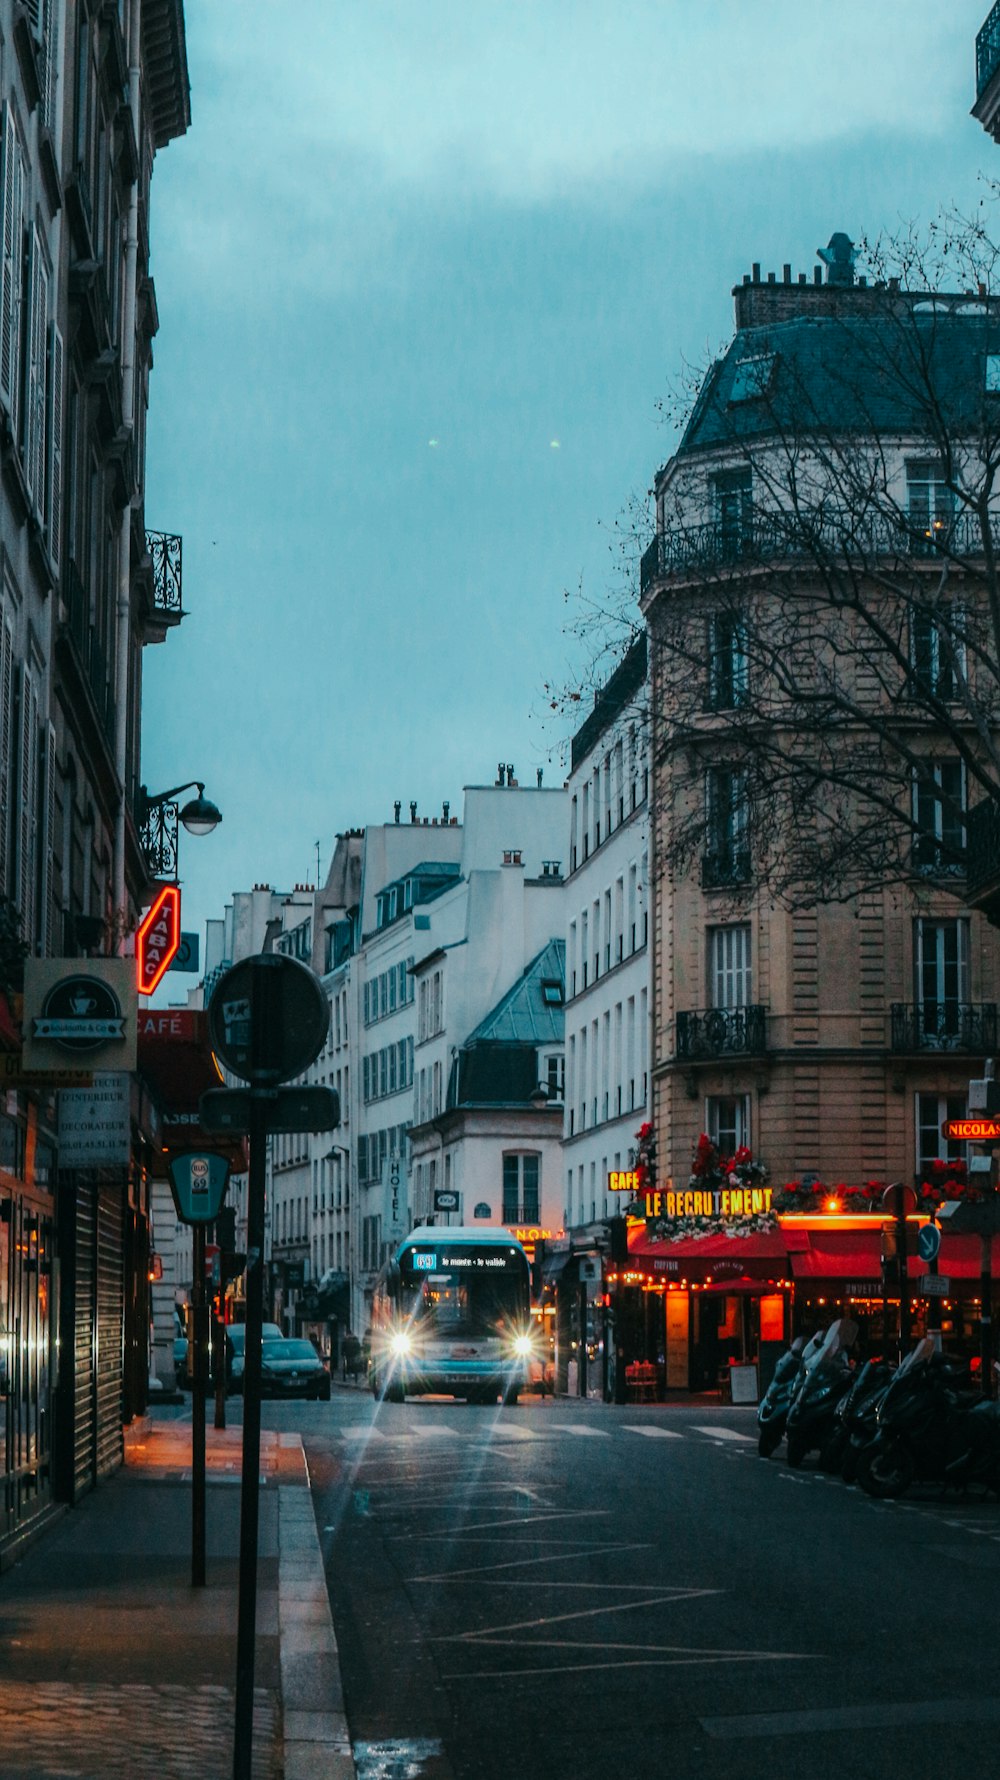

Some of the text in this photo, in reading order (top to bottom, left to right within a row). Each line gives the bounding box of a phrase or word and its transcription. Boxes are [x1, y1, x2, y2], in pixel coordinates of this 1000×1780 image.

[145, 906, 172, 975] TABAC
[194, 1178, 206, 1188] 69
[390, 1163, 400, 1221] HOTEL
[645, 1188, 773, 1217] LE RECRUTEMENT
[417, 1254, 434, 1269] 69
